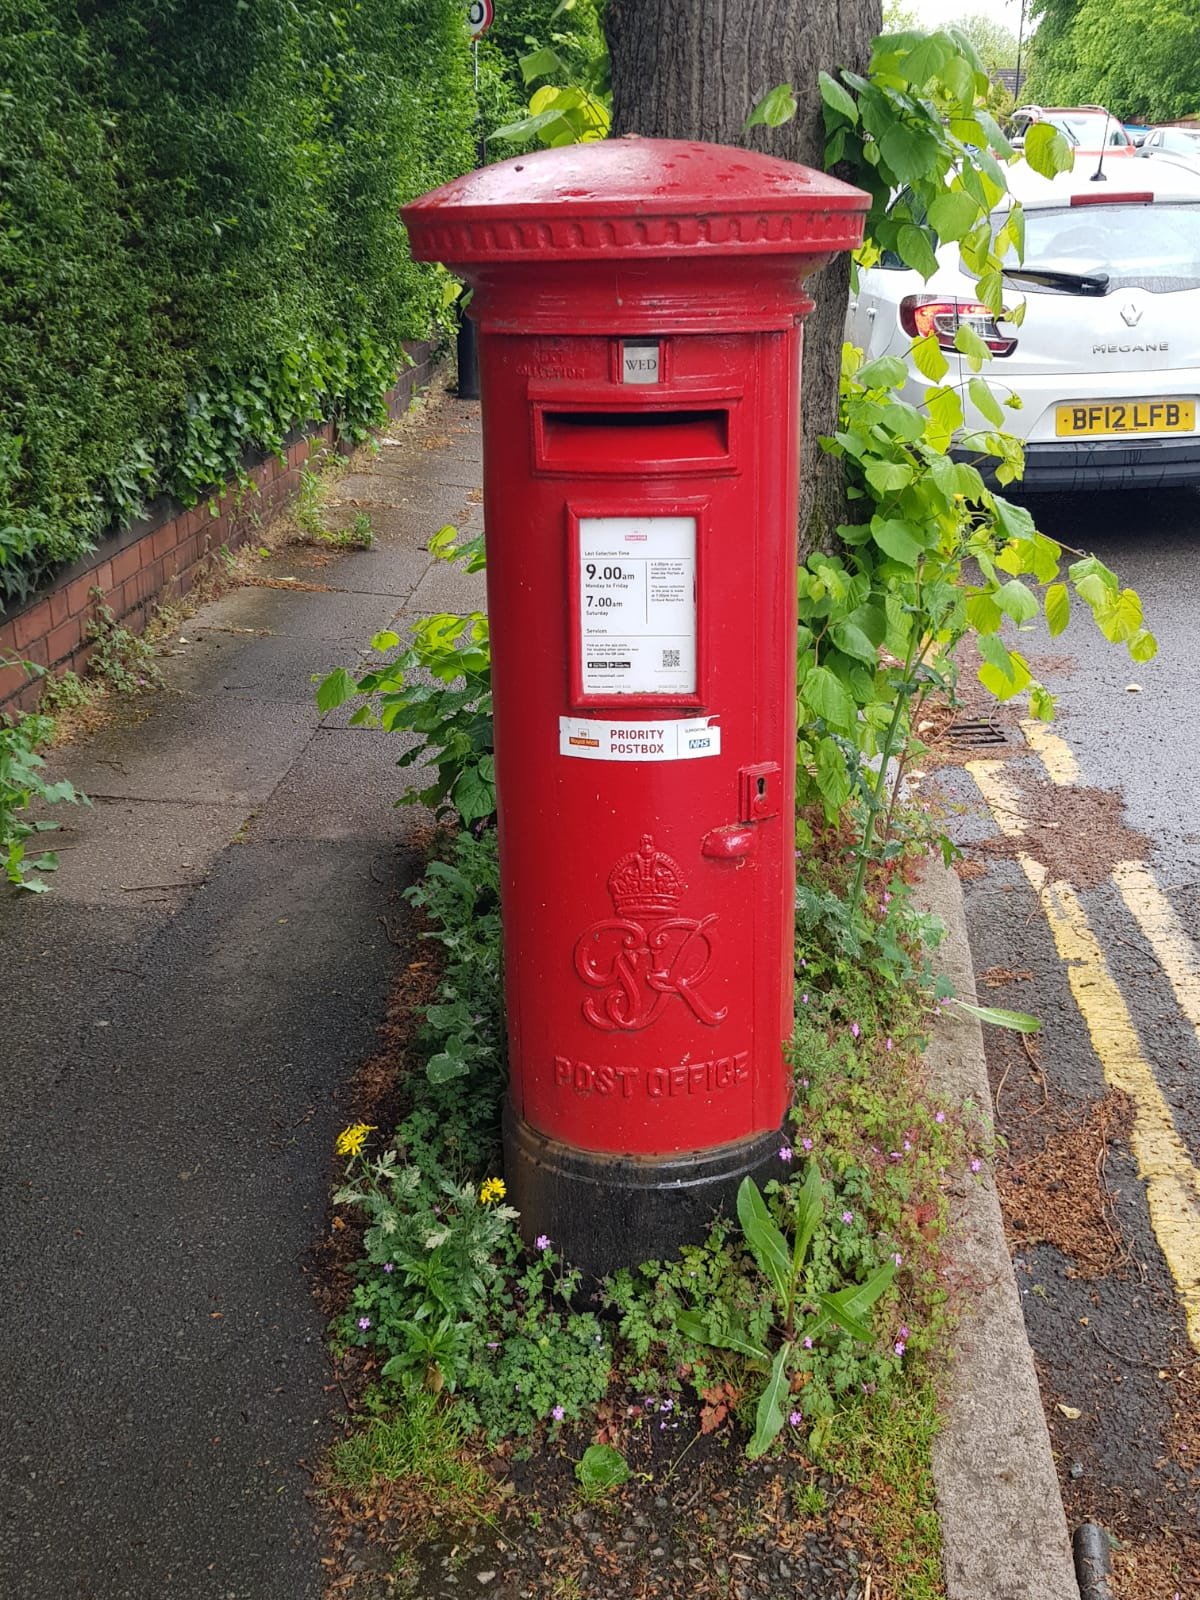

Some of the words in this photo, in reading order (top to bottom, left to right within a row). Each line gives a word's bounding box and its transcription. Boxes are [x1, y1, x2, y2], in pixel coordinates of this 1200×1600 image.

[1092, 342, 1169, 354] MEGANE
[625, 359, 657, 371] WED
[1072, 406, 1126, 430] BF12
[1133, 404, 1180, 427] LFB
[610, 729, 664, 740] PRIORITY
[610, 744, 664, 754] POSTBOX
[690, 738, 709, 748] NHS
[554, 1055, 639, 1098] POST
[647, 1051, 749, 1098] OFFICE
